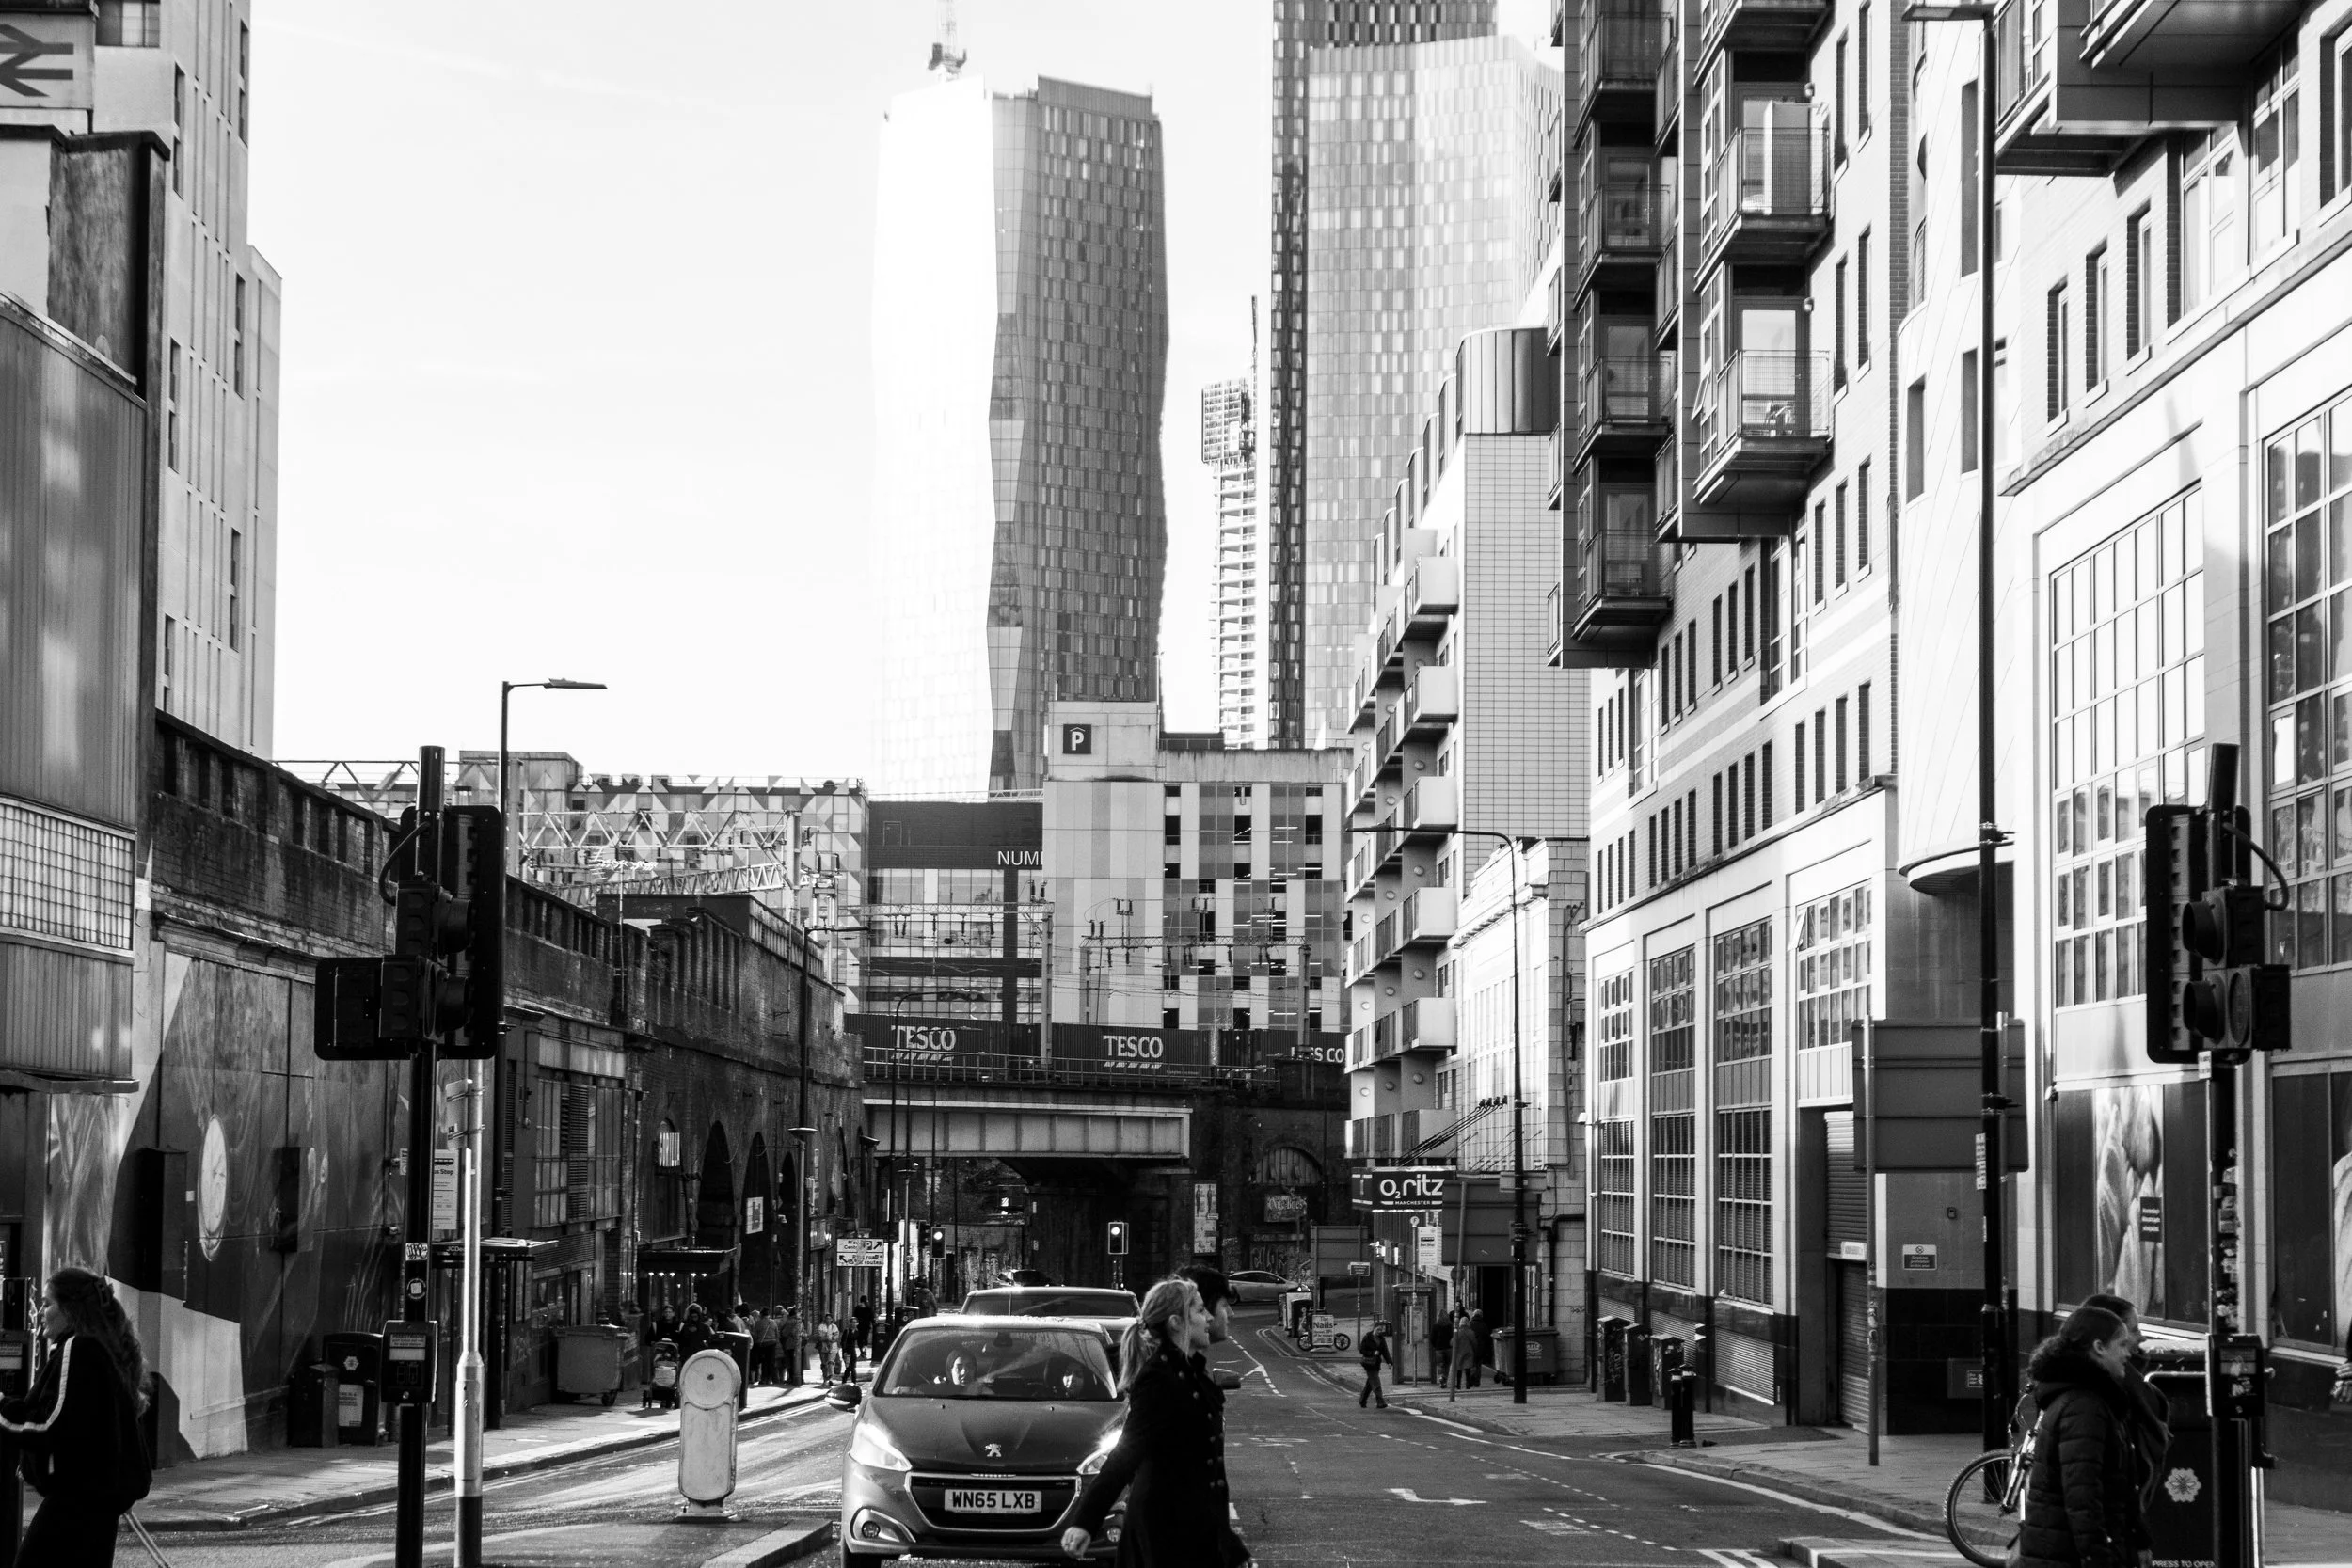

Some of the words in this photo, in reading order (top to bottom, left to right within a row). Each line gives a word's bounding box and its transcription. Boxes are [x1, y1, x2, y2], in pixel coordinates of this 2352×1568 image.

[1072, 731, 1085, 751] P
[997, 850, 1043, 865] NUM
[890, 1025, 957, 1051] TESCO
[1103, 1035, 1164, 1058] TESCO
[440, 1168, 454, 1177] Stop
[1403, 1173, 1445, 1196] ritz
[1312, 1321, 1334, 1329] Nails
[952, 1491, 997, 1508] WN65
[1001, 1492, 1035, 1509] LXB
[2180, 1560, 2193, 1568] TO
